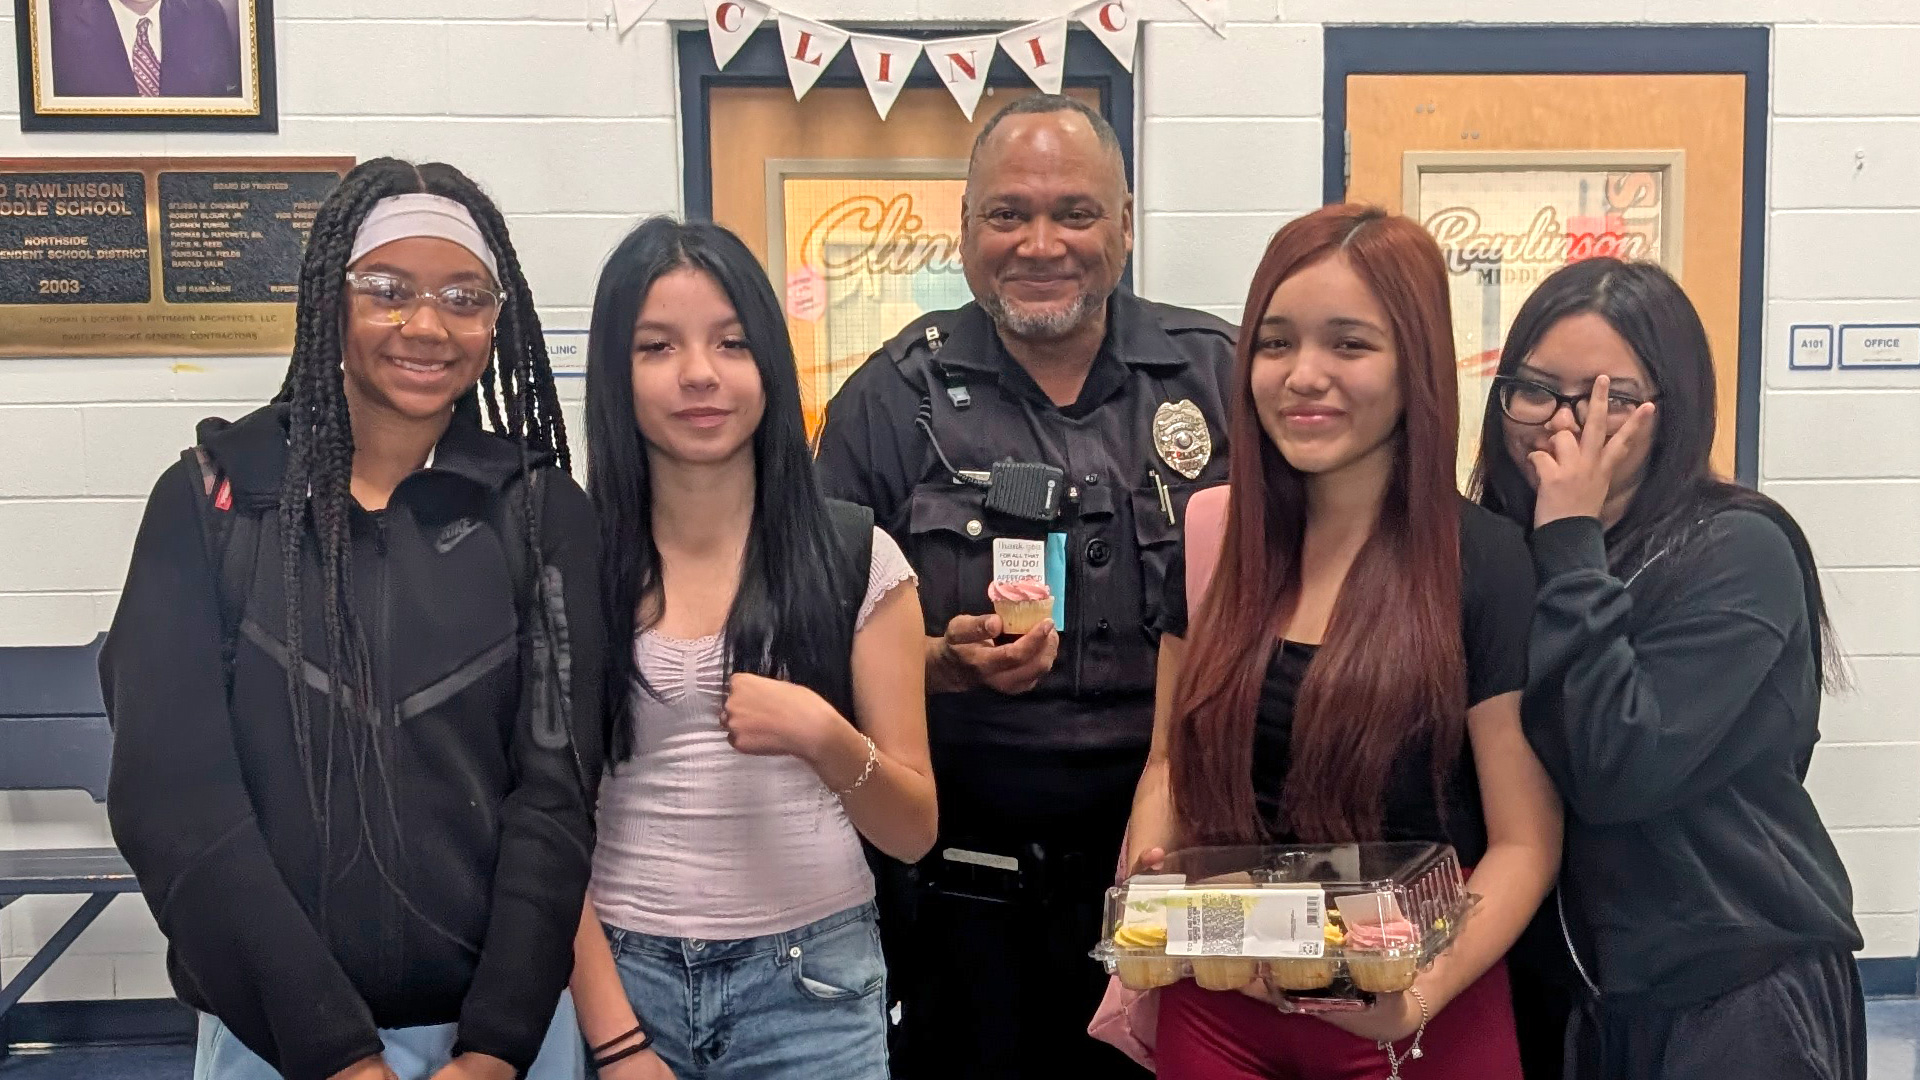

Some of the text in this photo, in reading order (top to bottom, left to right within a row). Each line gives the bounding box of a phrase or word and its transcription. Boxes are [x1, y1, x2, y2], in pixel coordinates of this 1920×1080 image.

[15, 183, 125, 198] RAWLINSON
[55, 201, 132, 216] SCHOOL
[24, 236, 89, 246] NORTHSIDE
[1425, 206, 1648, 276] Rawlinson
[47, 250, 95, 260] SCHOOL
[96, 249, 148, 260] DISTRICT
[39, 280, 80, 294] 2003
[1801, 339, 1824, 348] A101
[1863, 338, 1900, 348] OFFICE
[546, 345, 578, 355] LINIC
[998, 541, 1024, 550] Thank
